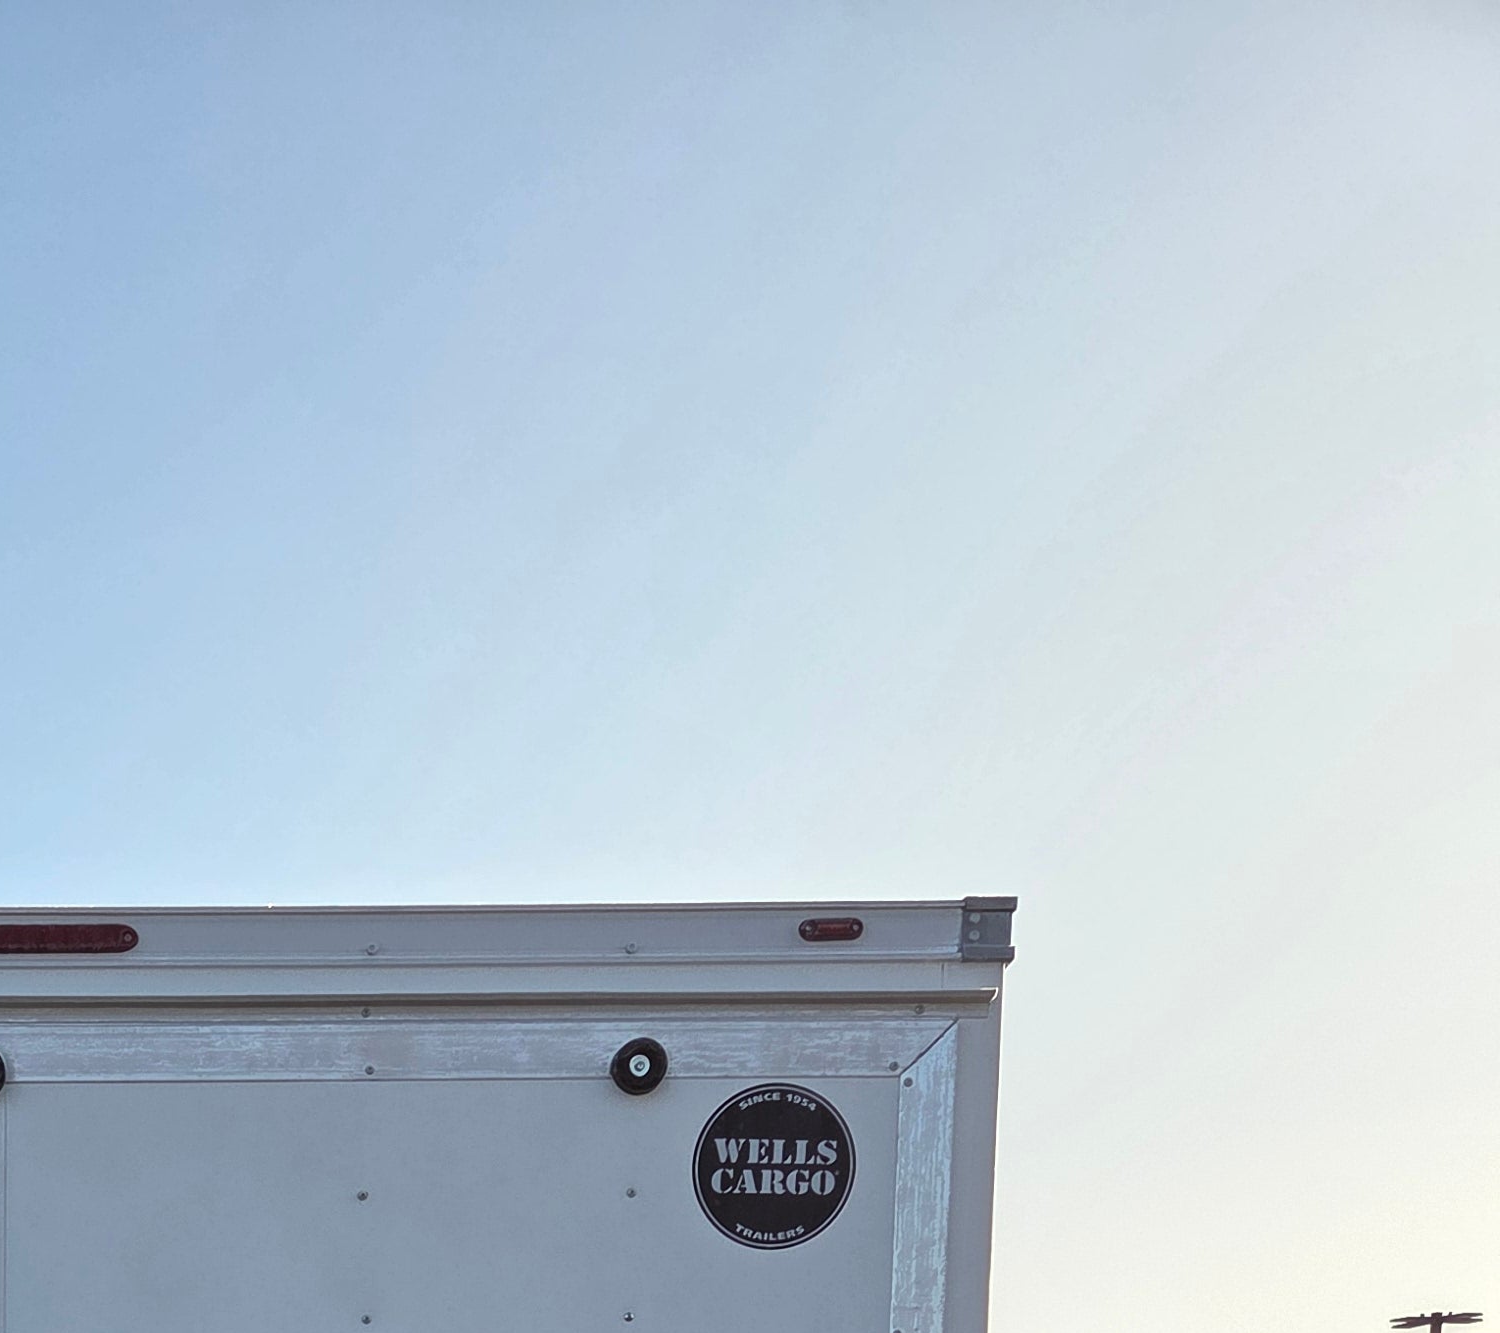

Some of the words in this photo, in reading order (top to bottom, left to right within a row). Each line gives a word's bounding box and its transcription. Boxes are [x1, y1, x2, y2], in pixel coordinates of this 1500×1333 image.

[739, 1092, 781, 1111] SINCE
[786, 1093, 818, 1111] 1954
[714, 1137, 838, 1165] WELLS
[711, 1168, 836, 1196] CARGO
[735, 1223, 805, 1241] TRAILERS
